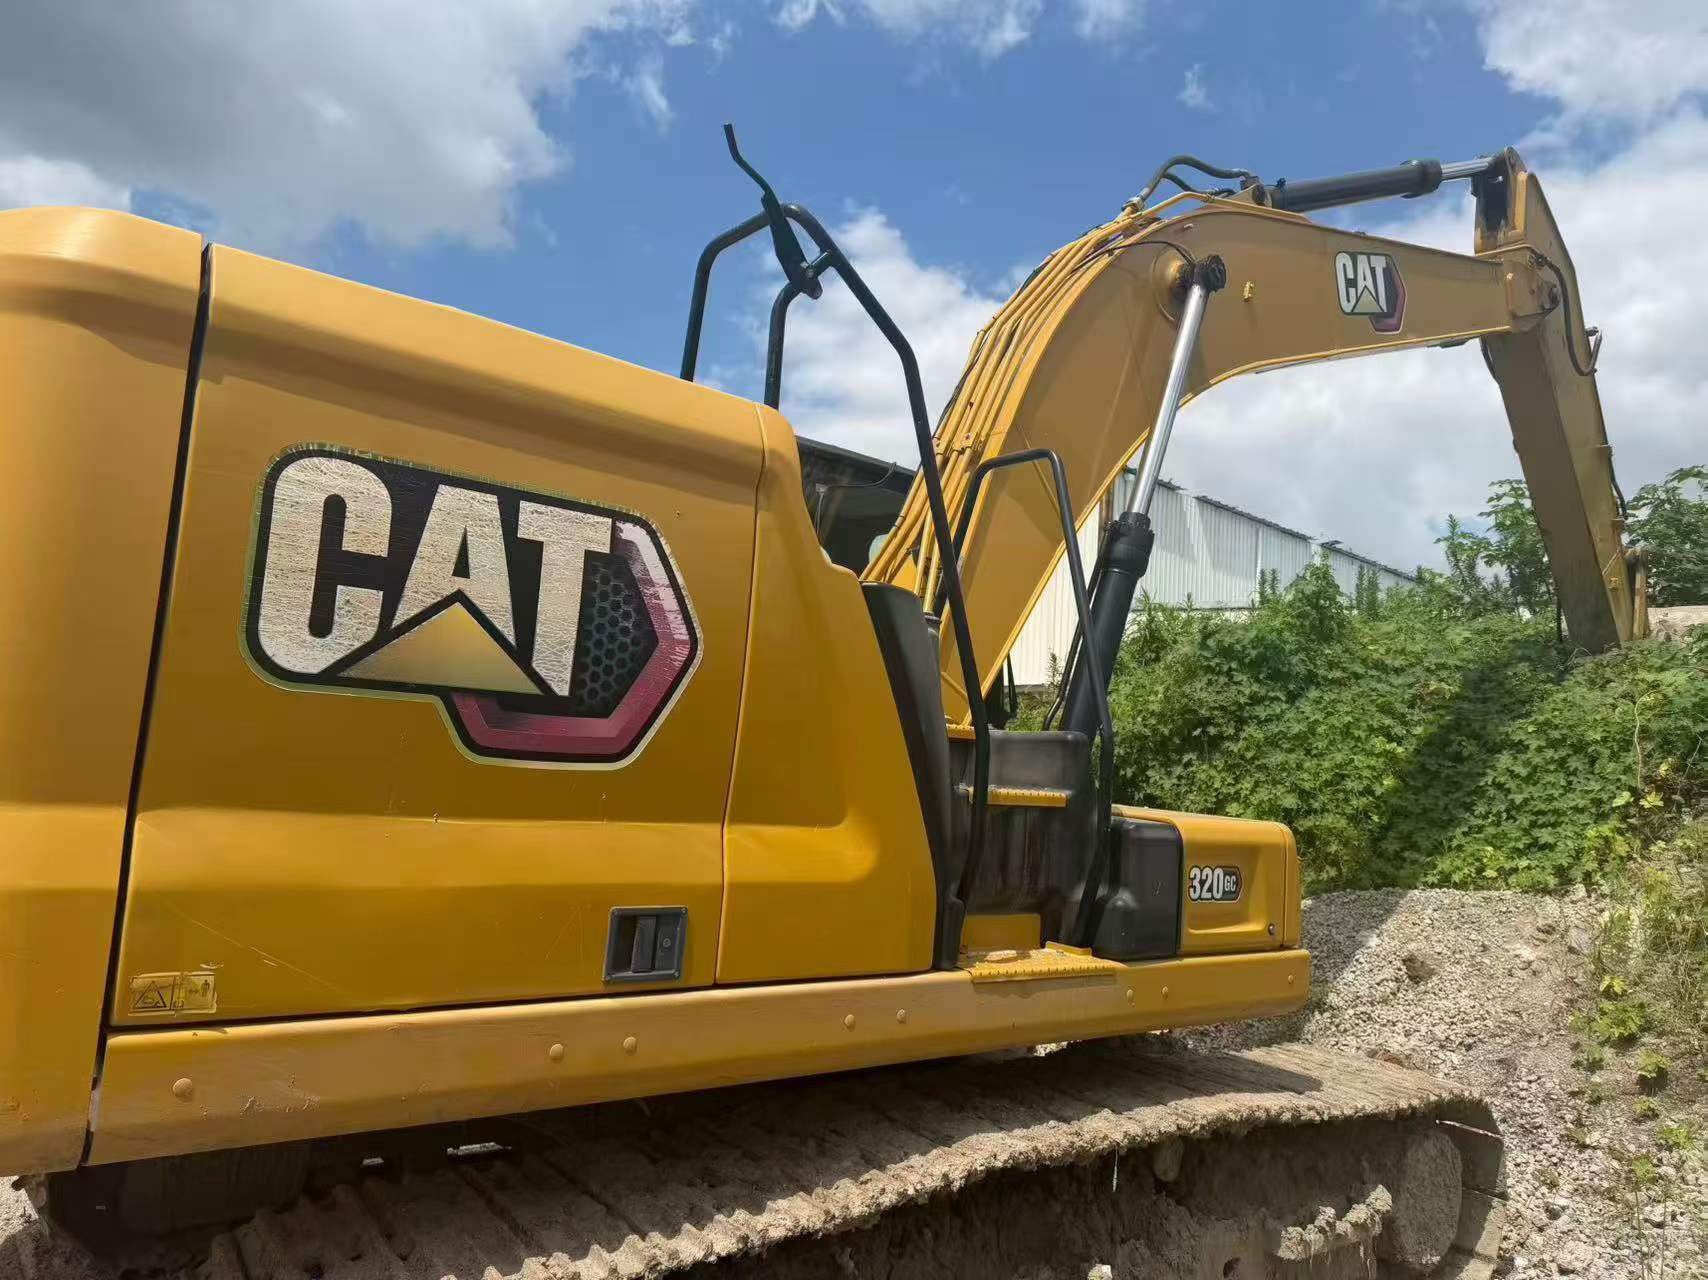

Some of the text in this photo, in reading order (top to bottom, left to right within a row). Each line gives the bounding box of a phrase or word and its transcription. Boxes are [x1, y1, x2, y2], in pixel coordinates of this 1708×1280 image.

[1335, 252, 1387, 312] CAT
[258, 456, 613, 697] CAT
[1189, 867, 1224, 900] 320
